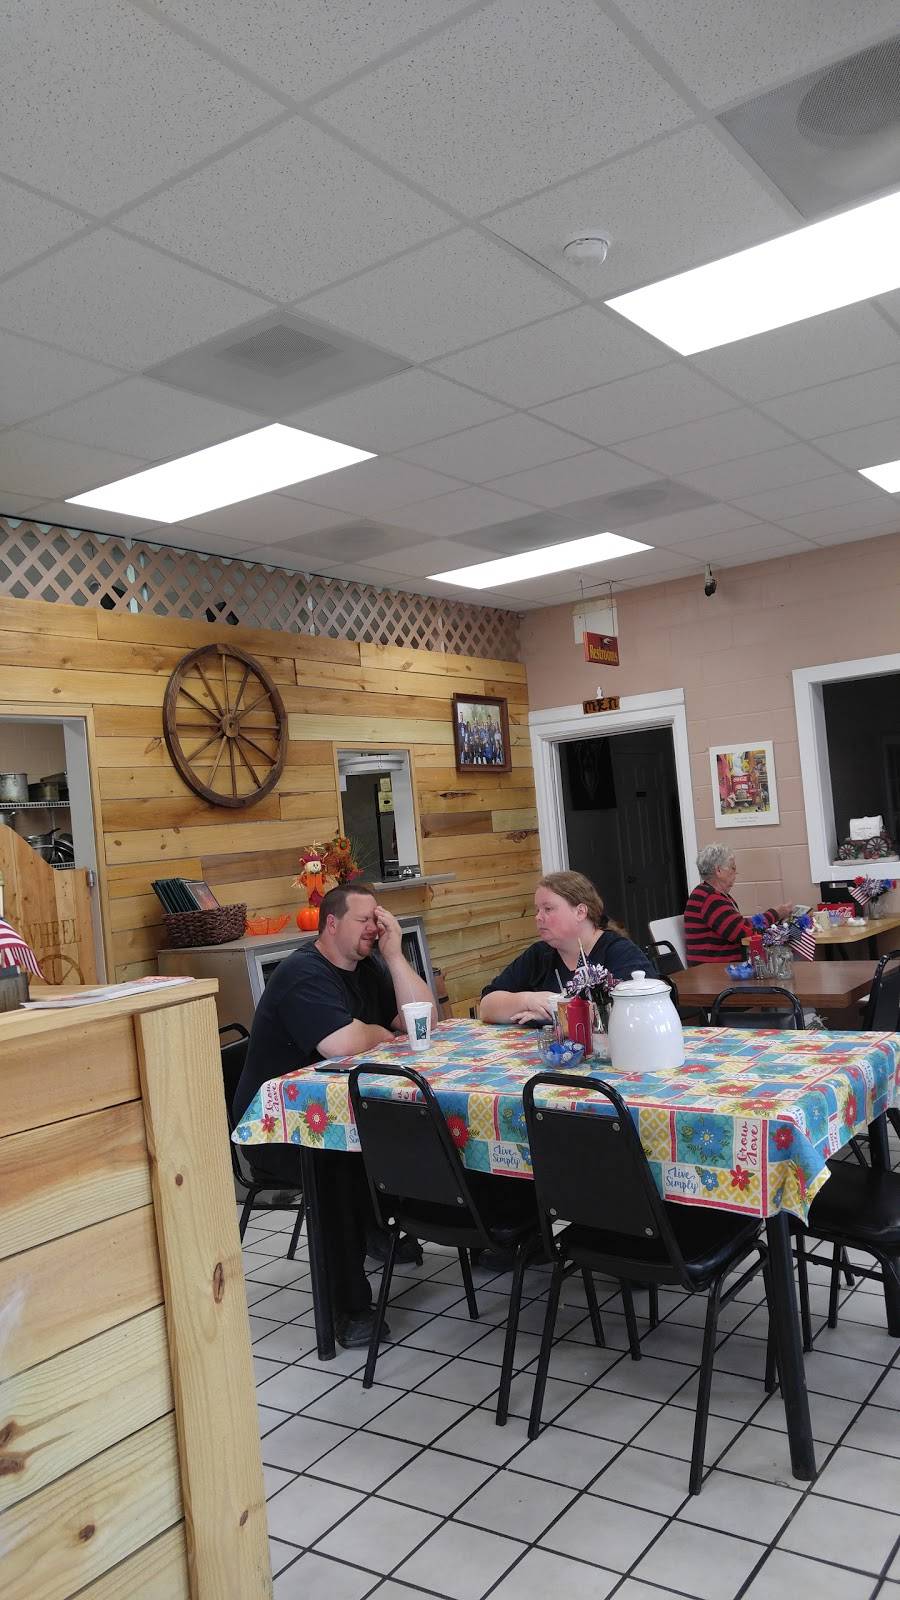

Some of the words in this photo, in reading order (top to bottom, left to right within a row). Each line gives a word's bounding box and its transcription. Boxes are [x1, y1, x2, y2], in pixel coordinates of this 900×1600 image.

[589, 644, 618, 662] Restrooms
[493, 1144, 517, 1157] Live
[737, 1121, 748, 1165] Grow
[492, 1153, 521, 1168] Simply
[667, 1166, 696, 1180] Live
[665, 1176, 699, 1193] Simply
